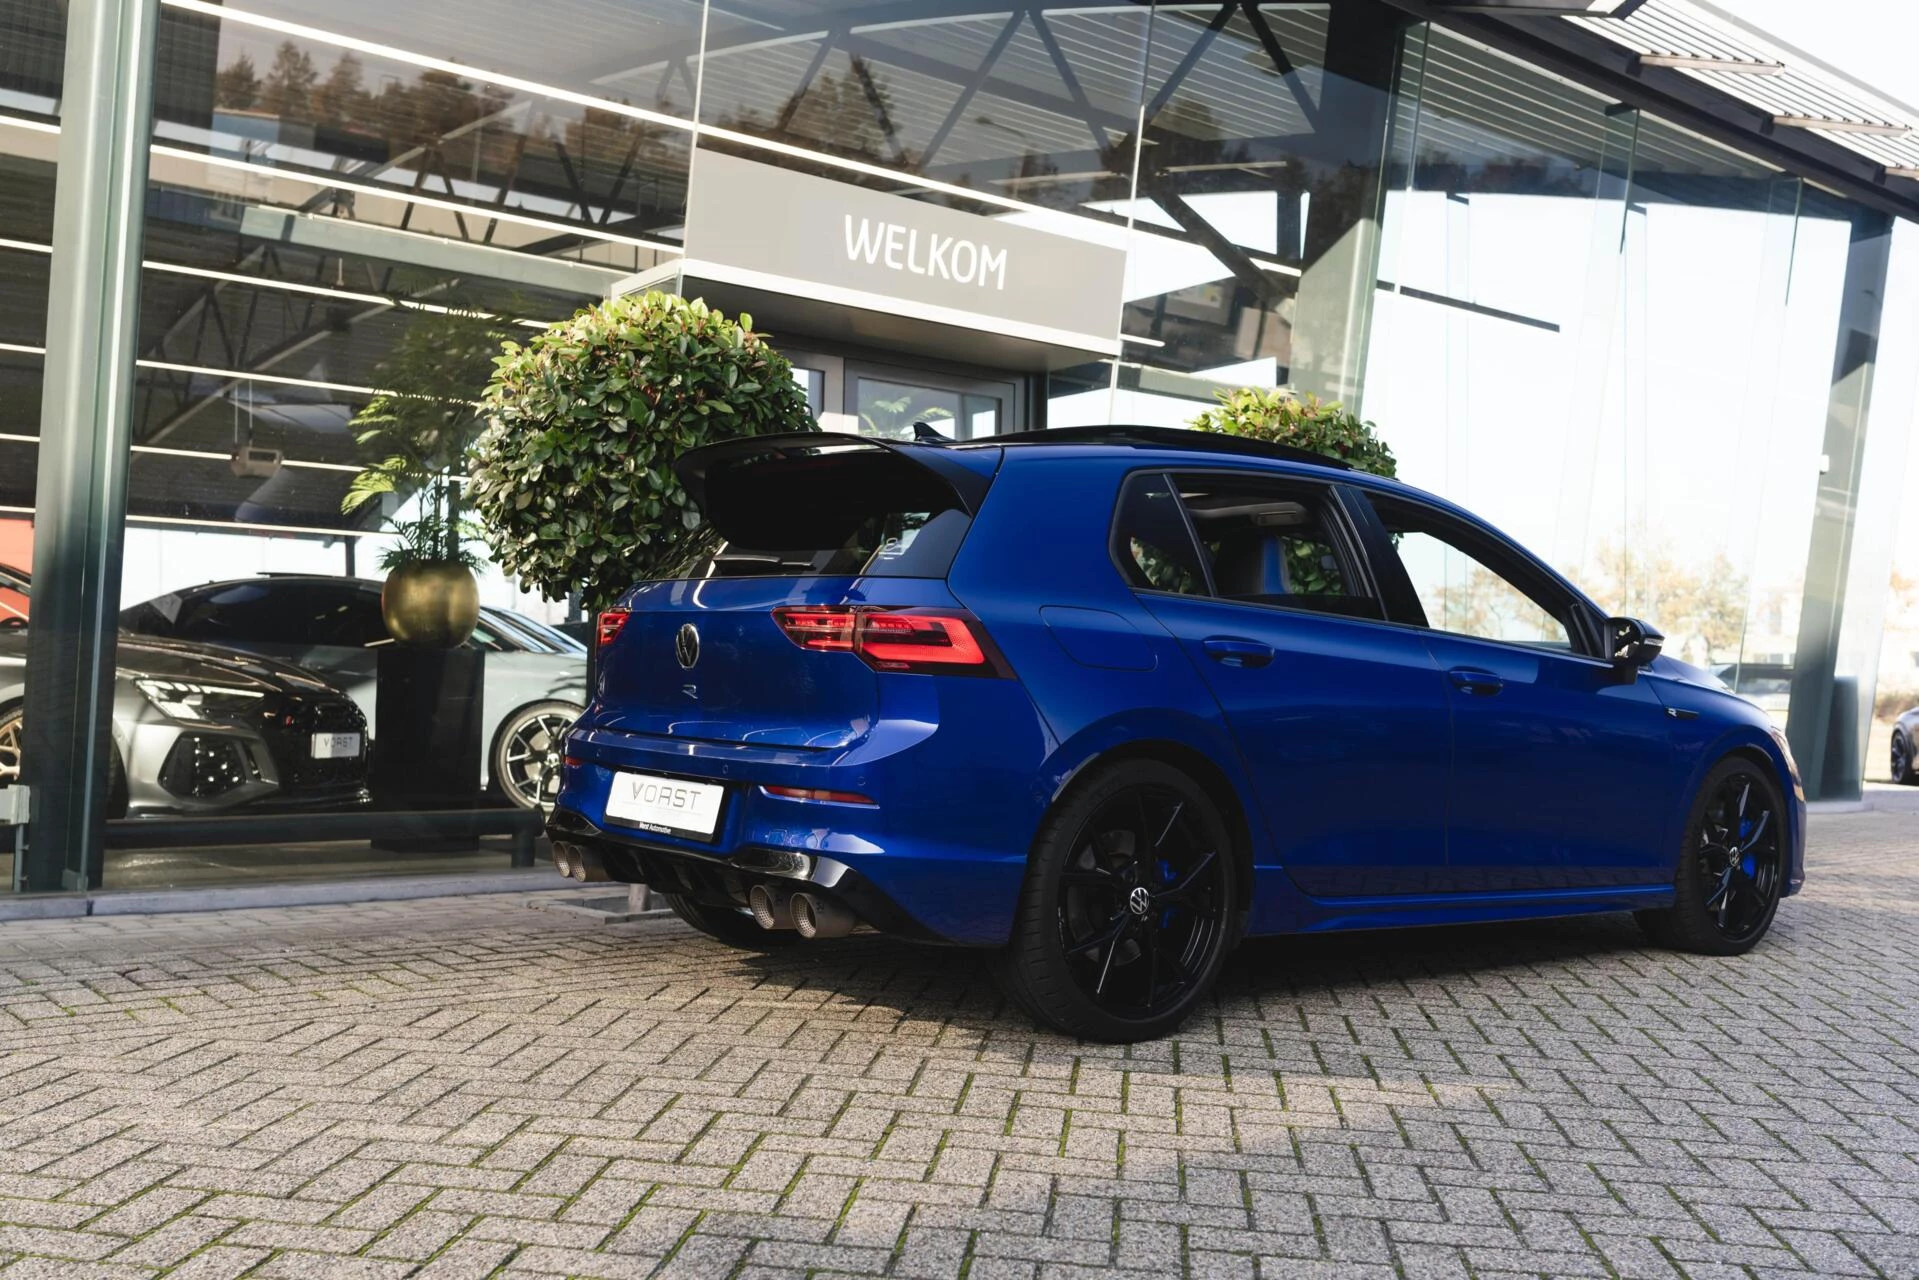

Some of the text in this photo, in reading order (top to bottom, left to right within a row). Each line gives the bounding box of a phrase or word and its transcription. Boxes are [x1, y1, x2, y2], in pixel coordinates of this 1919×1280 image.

[845, 214, 1008, 290] WELKOM
[323, 736, 353, 748] VORST
[632, 782, 702, 810] VORST
[649, 823, 671, 834] Automotive
